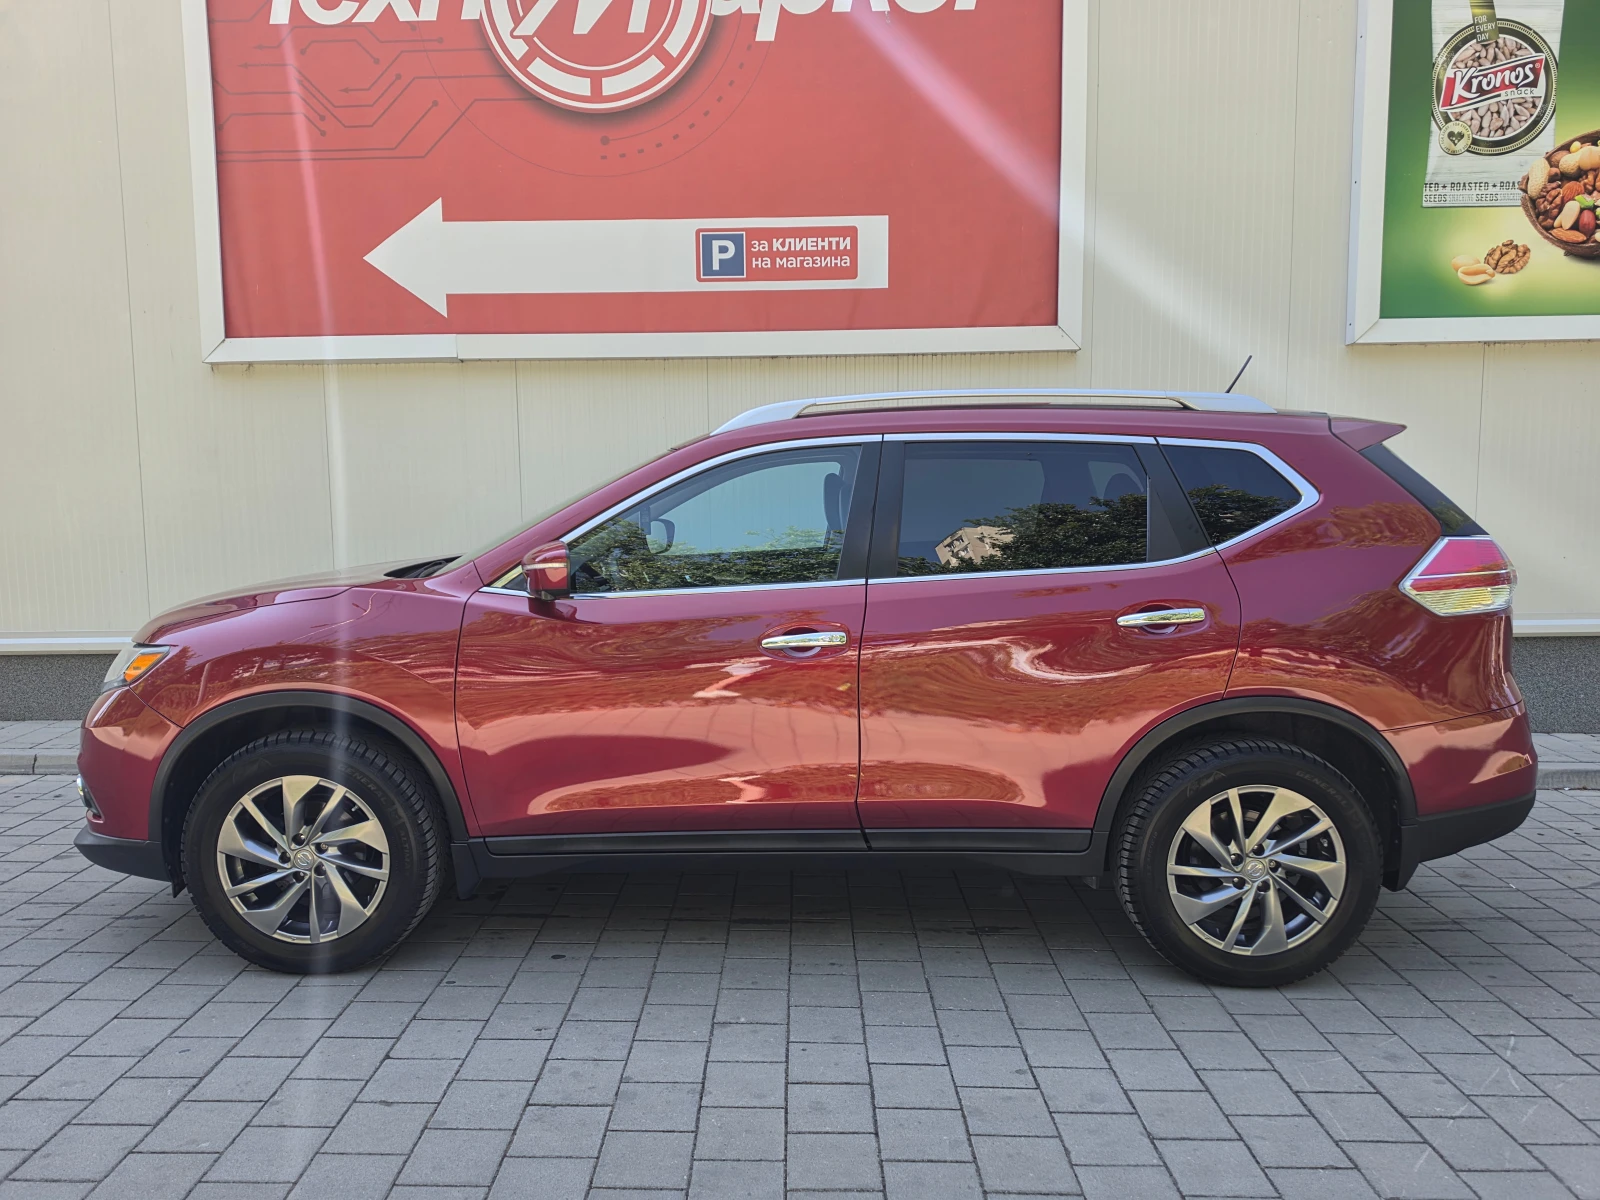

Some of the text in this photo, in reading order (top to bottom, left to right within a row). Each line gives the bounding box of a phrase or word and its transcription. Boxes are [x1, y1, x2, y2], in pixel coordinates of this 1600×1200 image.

[1474, 15, 1487, 24] FOR
[1475, 22, 1496, 33] EVERY
[1477, 34, 1489, 42] DAY
[1452, 63, 1535, 104] Kronos
[1504, 88, 1535, 97] snack
[1450, 181, 1489, 191] ROASTED
[1424, 194, 1448, 203] SEEDS
[1475, 193, 1499, 202] SEEDS
[751, 236, 851, 252] за КЛИЕНТИ
[711, 239, 736, 271] P
[752, 255, 850, 269] на магазина
[1295, 769, 1348, 807] GENERAL
